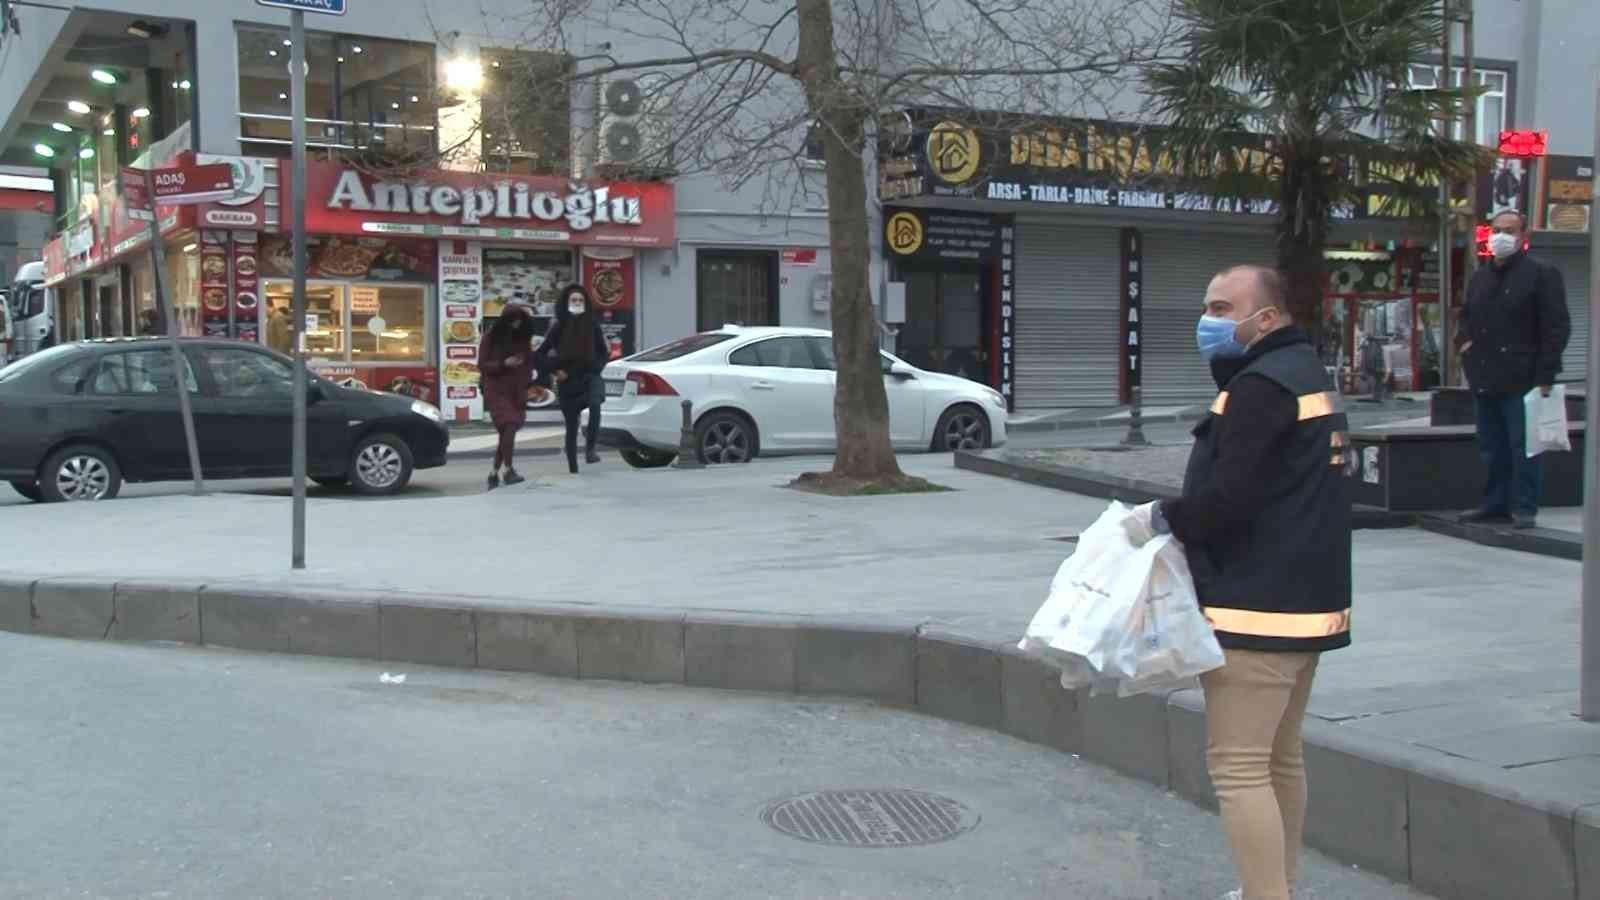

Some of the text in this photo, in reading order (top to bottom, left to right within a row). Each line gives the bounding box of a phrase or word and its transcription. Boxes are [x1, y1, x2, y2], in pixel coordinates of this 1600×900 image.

[327, 170, 643, 231] Anteplioğlu
[987, 182, 1022, 200] ARSA
[1029, 185, 1069, 202] TARLA
[1128, 236, 1138, 370] İNŞAAT
